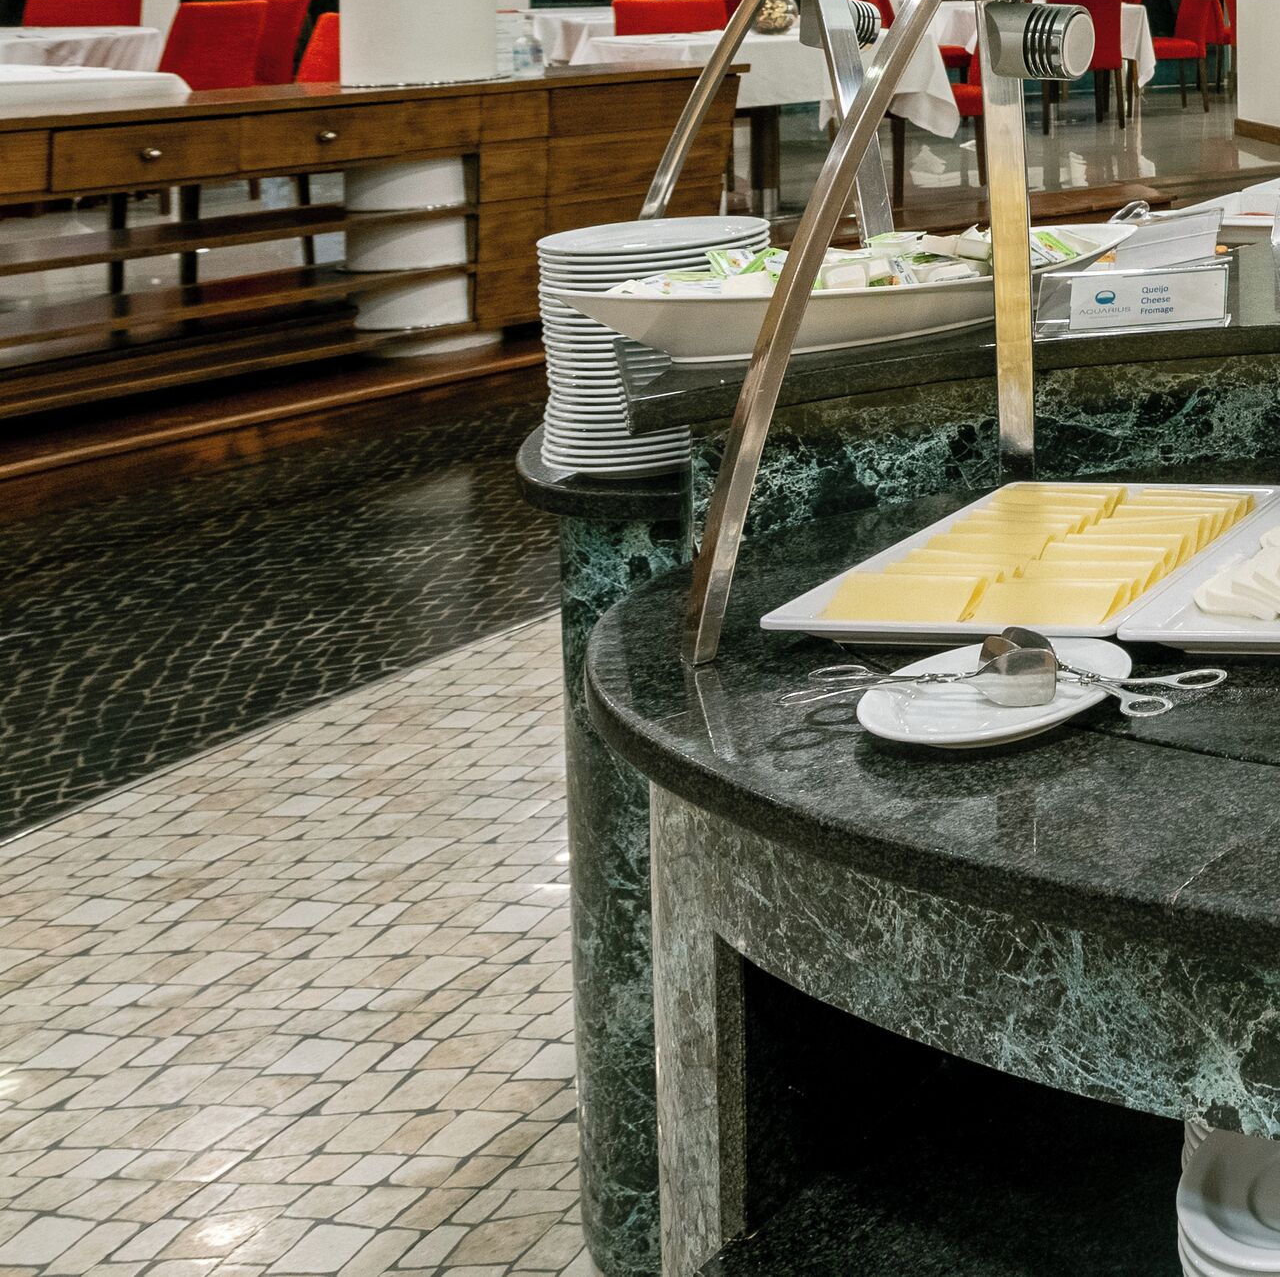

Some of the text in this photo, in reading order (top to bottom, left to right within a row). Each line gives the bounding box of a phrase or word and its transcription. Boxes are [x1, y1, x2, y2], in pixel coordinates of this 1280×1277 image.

[1141, 285, 1169, 295] Queijo
[1140, 296, 1171, 304] Cheese
[1078, 306, 1131, 316] AQUARIUS
[1140, 306, 1174, 315] Fromage
